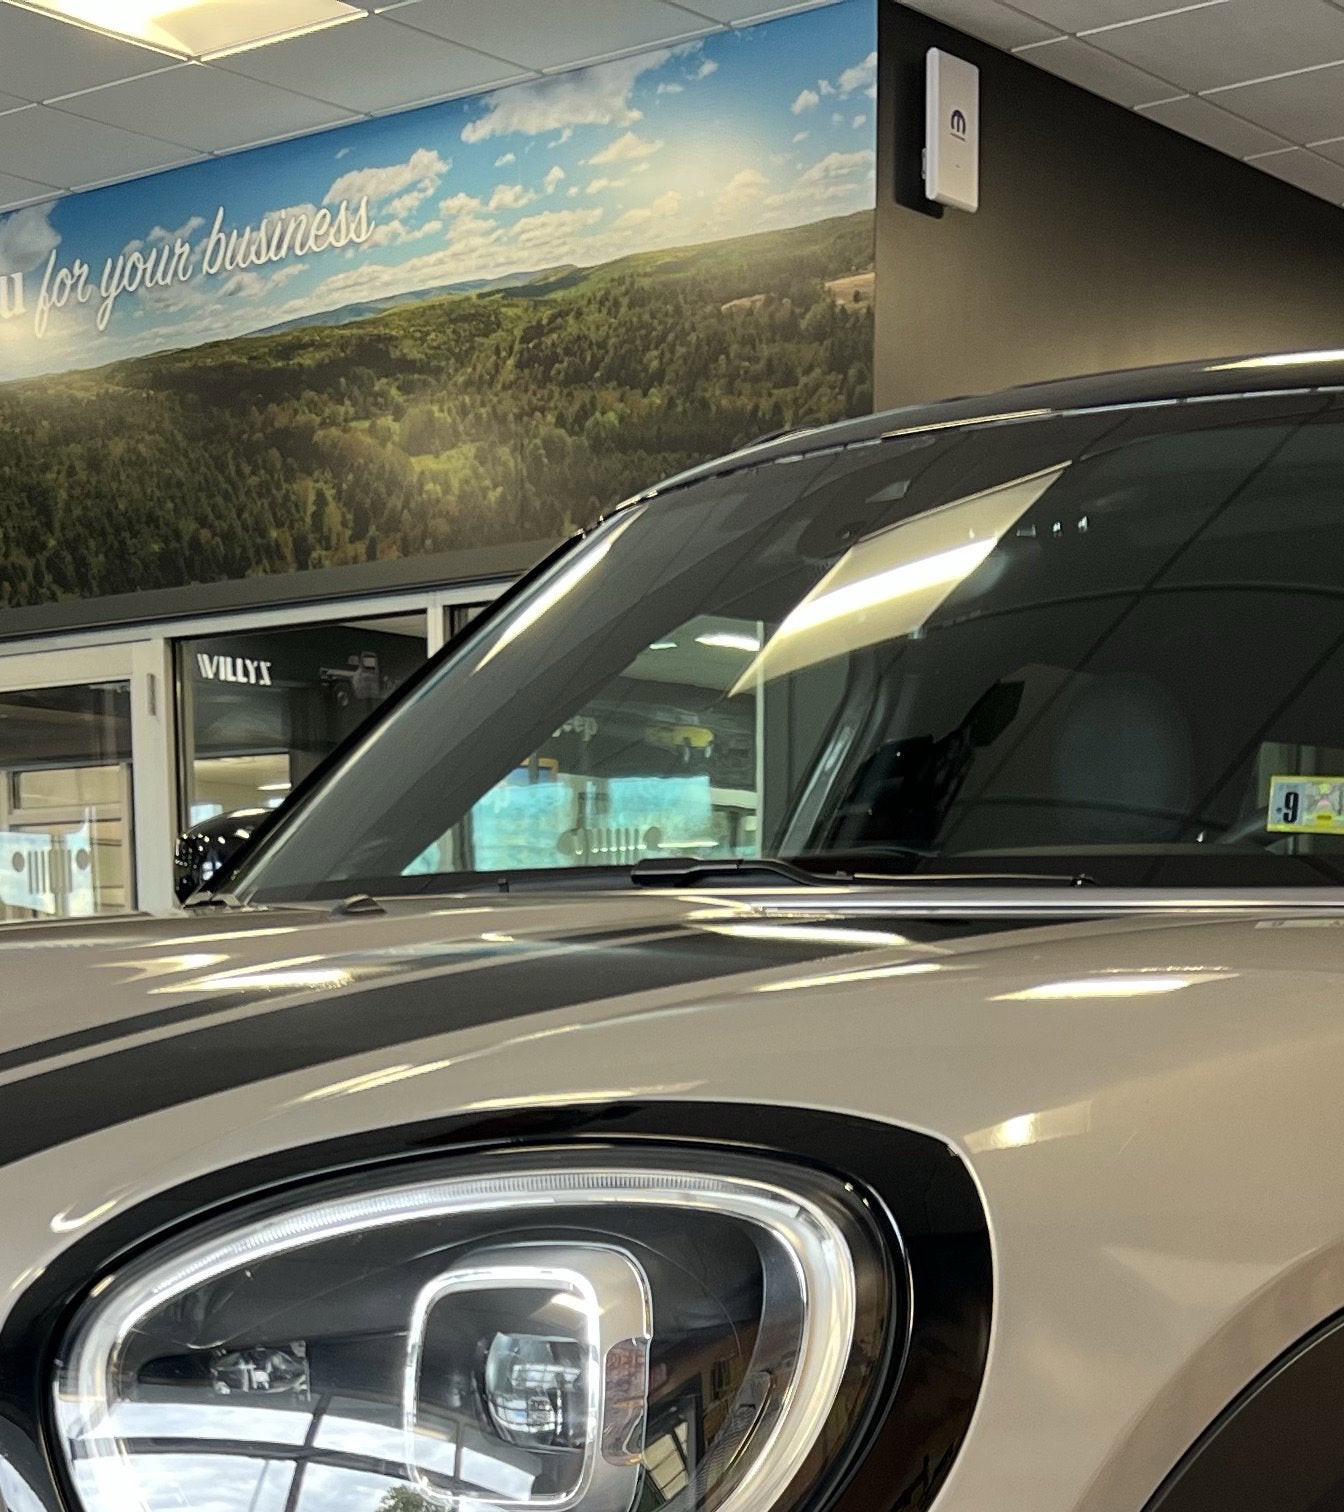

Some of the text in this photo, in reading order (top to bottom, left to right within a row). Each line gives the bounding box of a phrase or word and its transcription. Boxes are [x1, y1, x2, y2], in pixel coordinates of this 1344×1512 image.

[34, 248, 93, 337] for
[97, 240, 193, 330] your
[203, 196, 375, 274] business
[197, 653, 271, 685] WILLYS
[1284, 791, 1299, 824] 9
